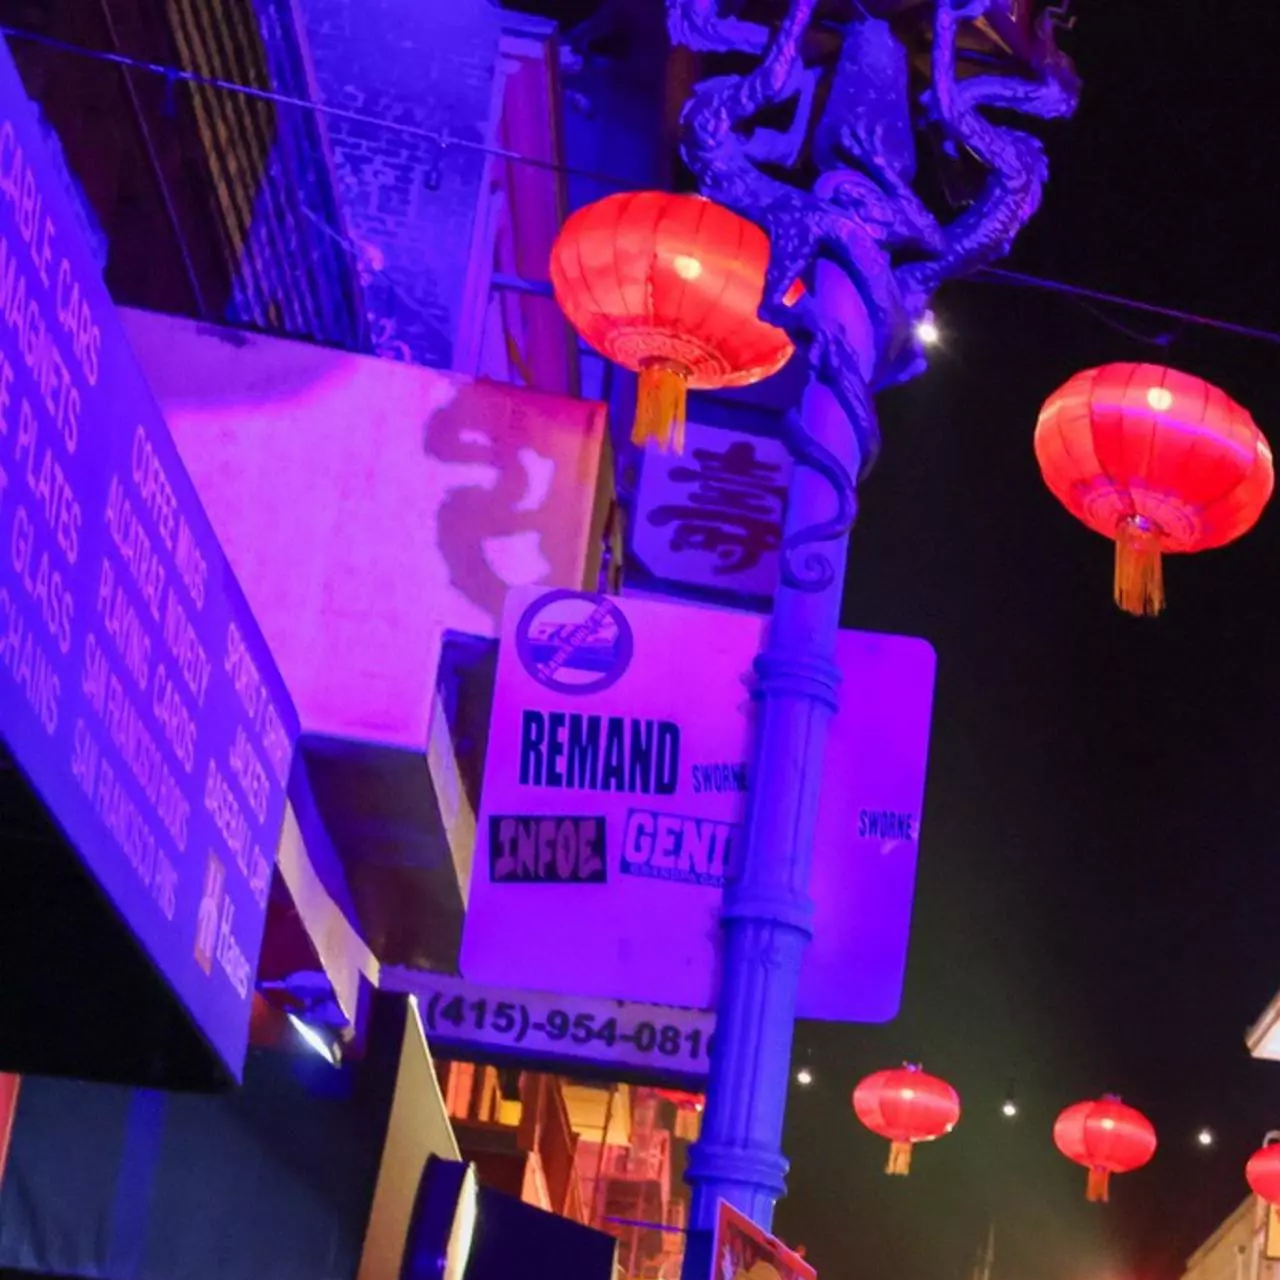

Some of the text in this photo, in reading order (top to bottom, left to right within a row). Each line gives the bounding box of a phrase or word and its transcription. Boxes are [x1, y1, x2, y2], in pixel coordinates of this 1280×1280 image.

[57, 256, 100, 385] CARS
[15, 396, 81, 565] PLATES
[105, 473, 165, 623] ALCATRAZ
[132, 424, 177, 553] COFFEE
[12, 504, 74, 655] GLASS
[82, 631, 109, 719] SAN
[103, 670, 163, 808] FRANCISCO
[98, 556, 196, 774] PLAYING CARDS
[519, 709, 682, 797] REMAND
[426, 991, 716, 1060] (415)-954-081
